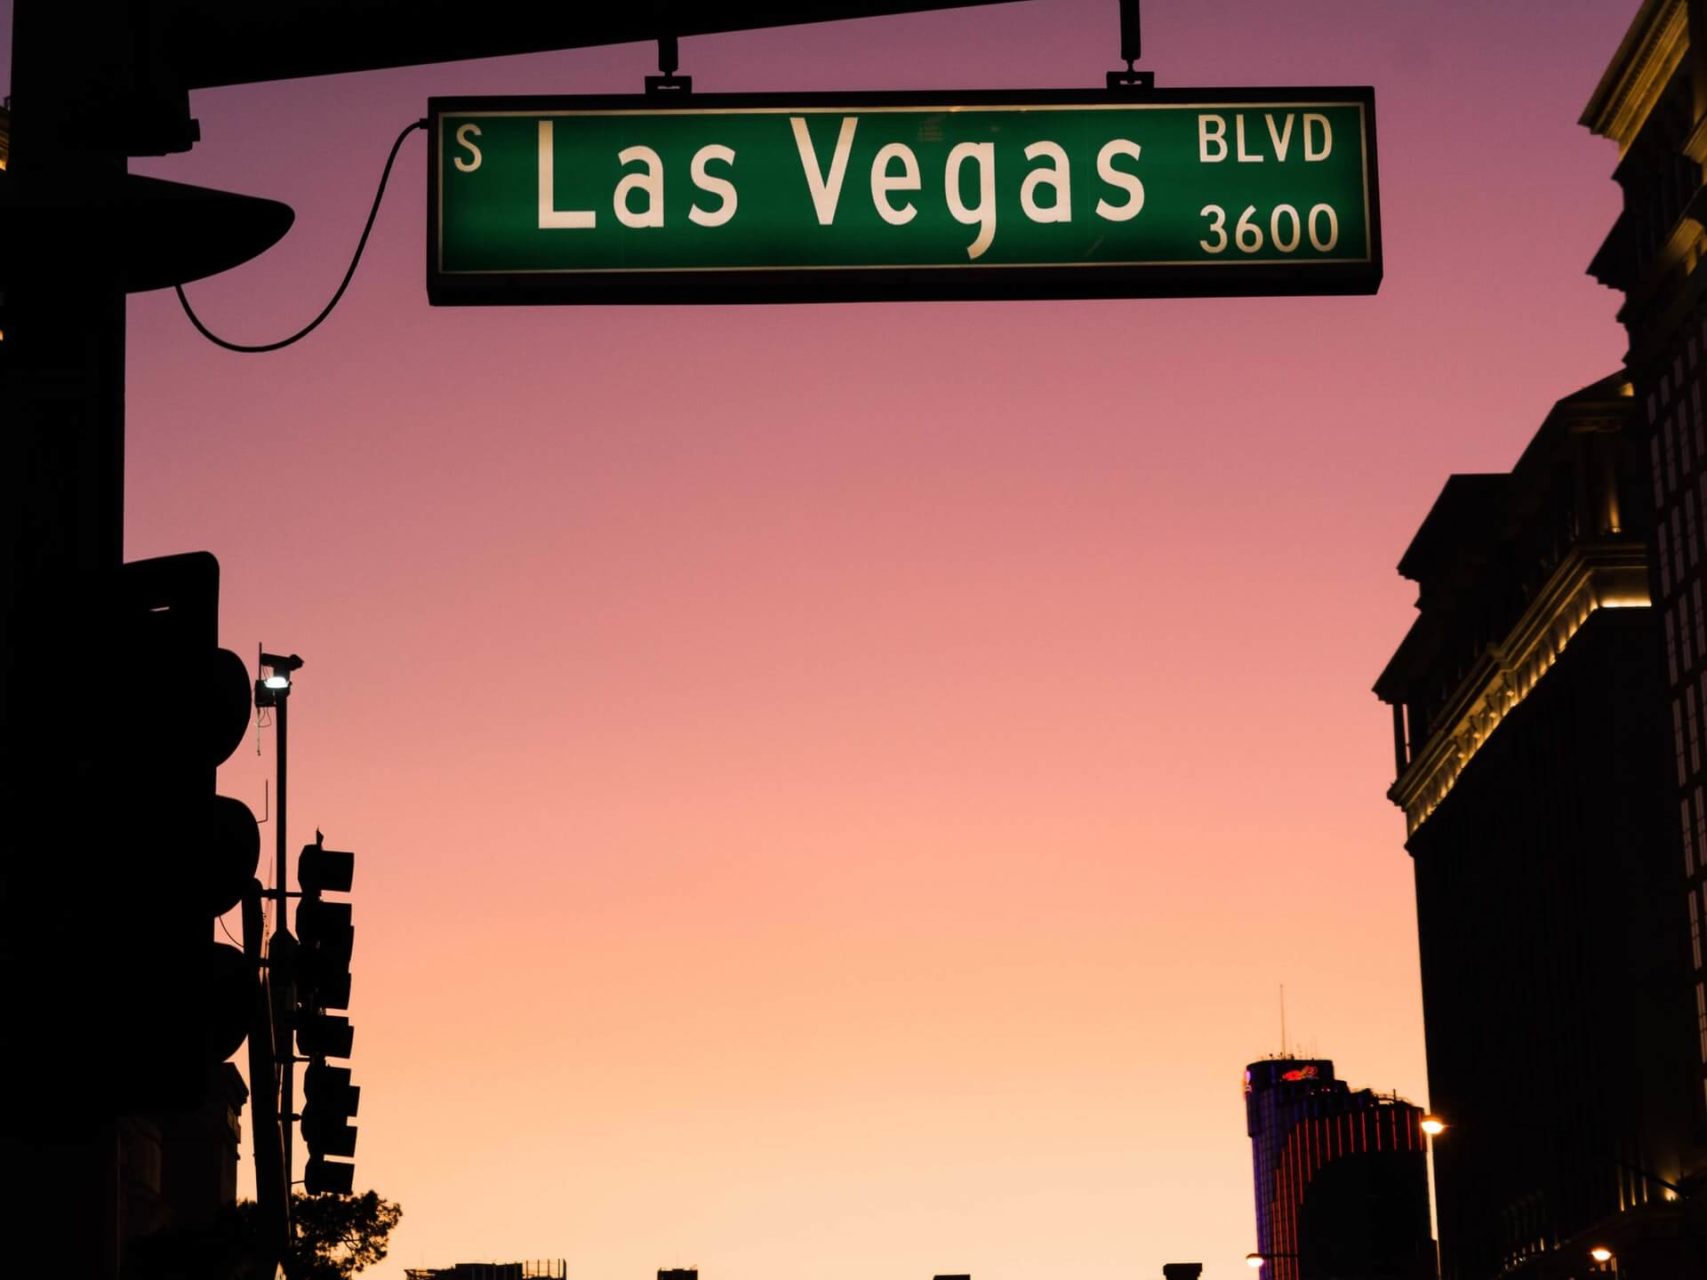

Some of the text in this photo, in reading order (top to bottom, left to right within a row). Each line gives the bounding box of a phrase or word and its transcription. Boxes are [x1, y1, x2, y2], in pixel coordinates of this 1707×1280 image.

[453, 112, 1334, 260] S Las Vegas BLVD
[1199, 203, 1340, 254] 3600
